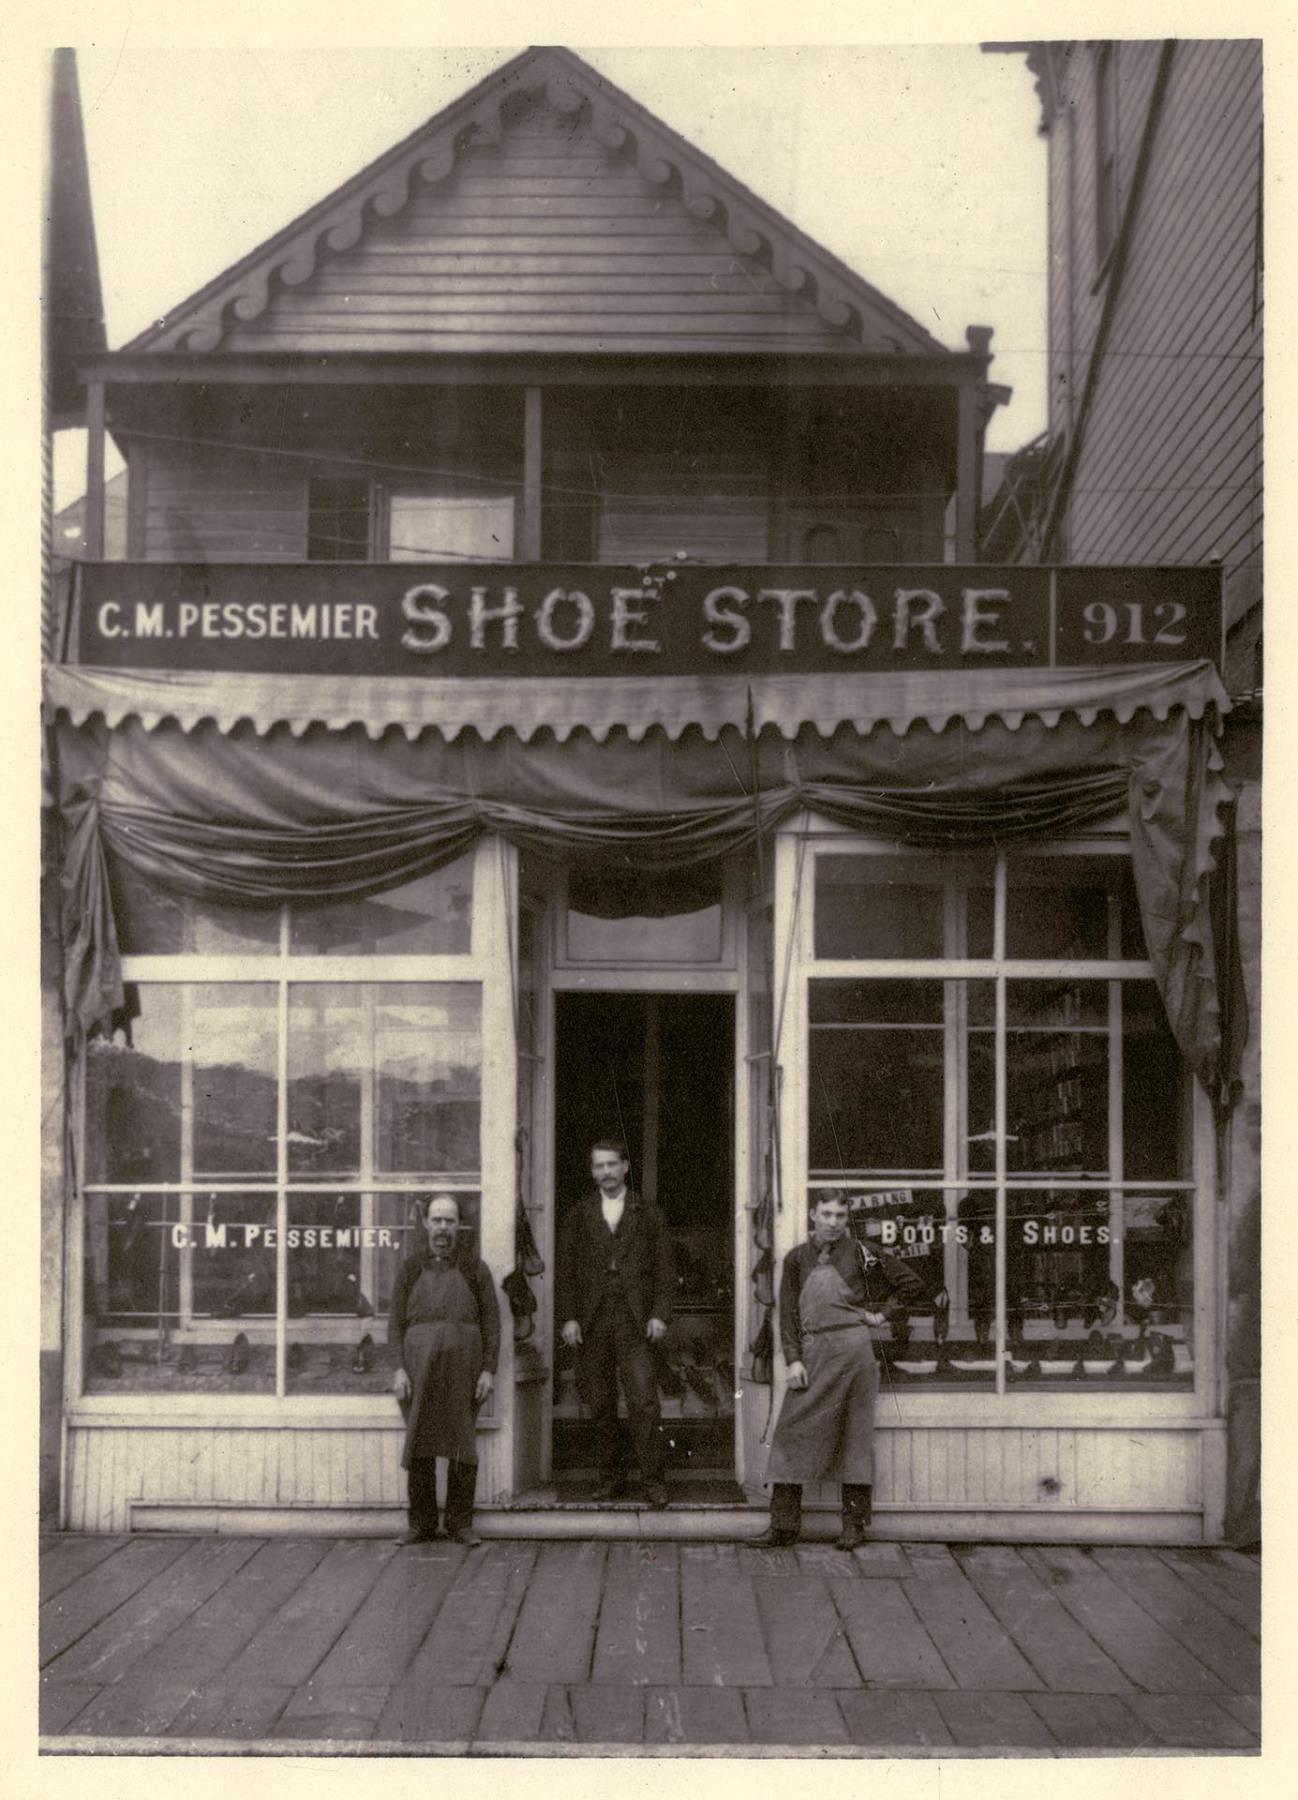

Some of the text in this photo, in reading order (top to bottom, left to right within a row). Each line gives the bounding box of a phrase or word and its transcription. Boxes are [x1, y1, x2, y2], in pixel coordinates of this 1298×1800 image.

[400, 584, 661, 650] SHOE
[702, 585, 1037, 653] STORE.
[1082, 602, 1187, 645] 912
[881, 1219, 968, 1244] BOOTS
[979, 1225, 994, 1244] &
